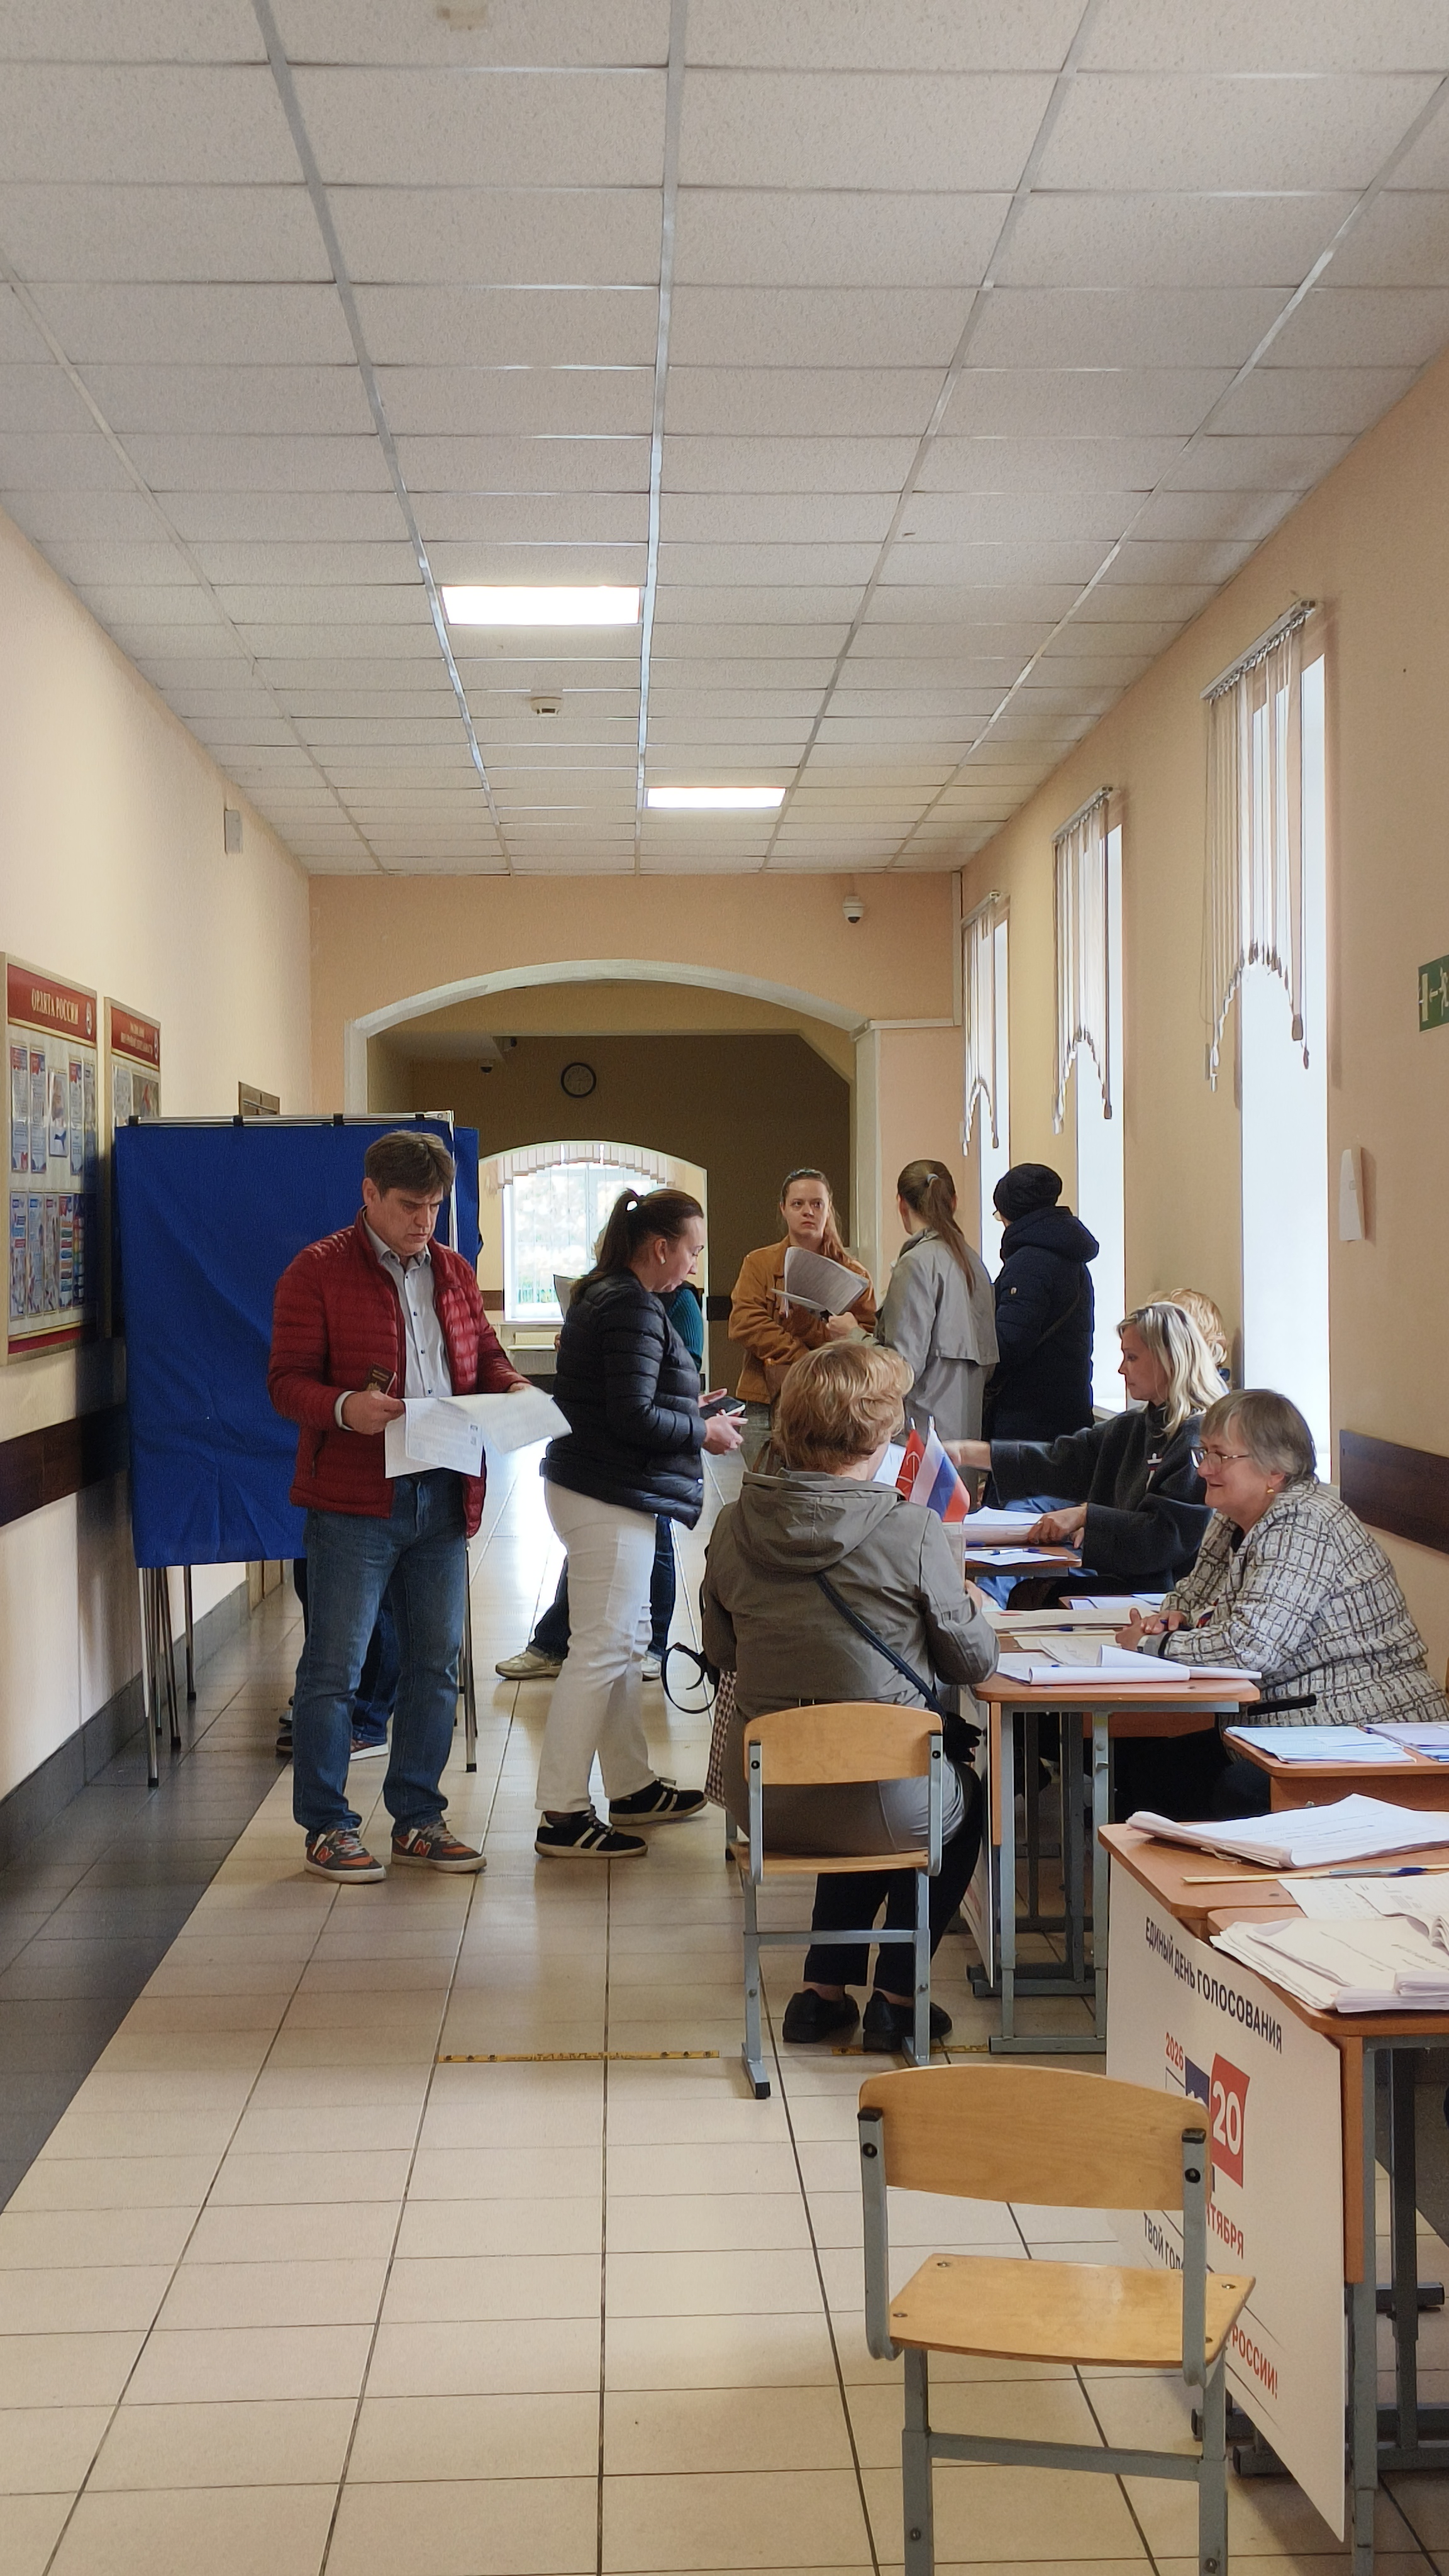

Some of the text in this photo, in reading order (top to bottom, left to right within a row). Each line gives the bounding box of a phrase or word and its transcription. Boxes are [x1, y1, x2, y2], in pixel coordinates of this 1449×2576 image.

[31, 988, 79, 1025] ОРЛЯТА РОССИИ
[1145, 1916, 1282, 2055] ЕДИНЫЙ ДЕНЬ ГОЛОСОВАНИЯ
[1165, 2031, 1184, 2071] 2026
[1213, 2080, 1243, 2155] 20
[1143, 2211, 1184, 2270] ТВОЙ ГОЛ
[1206, 2201, 1244, 2260] ТЯБРЯ
